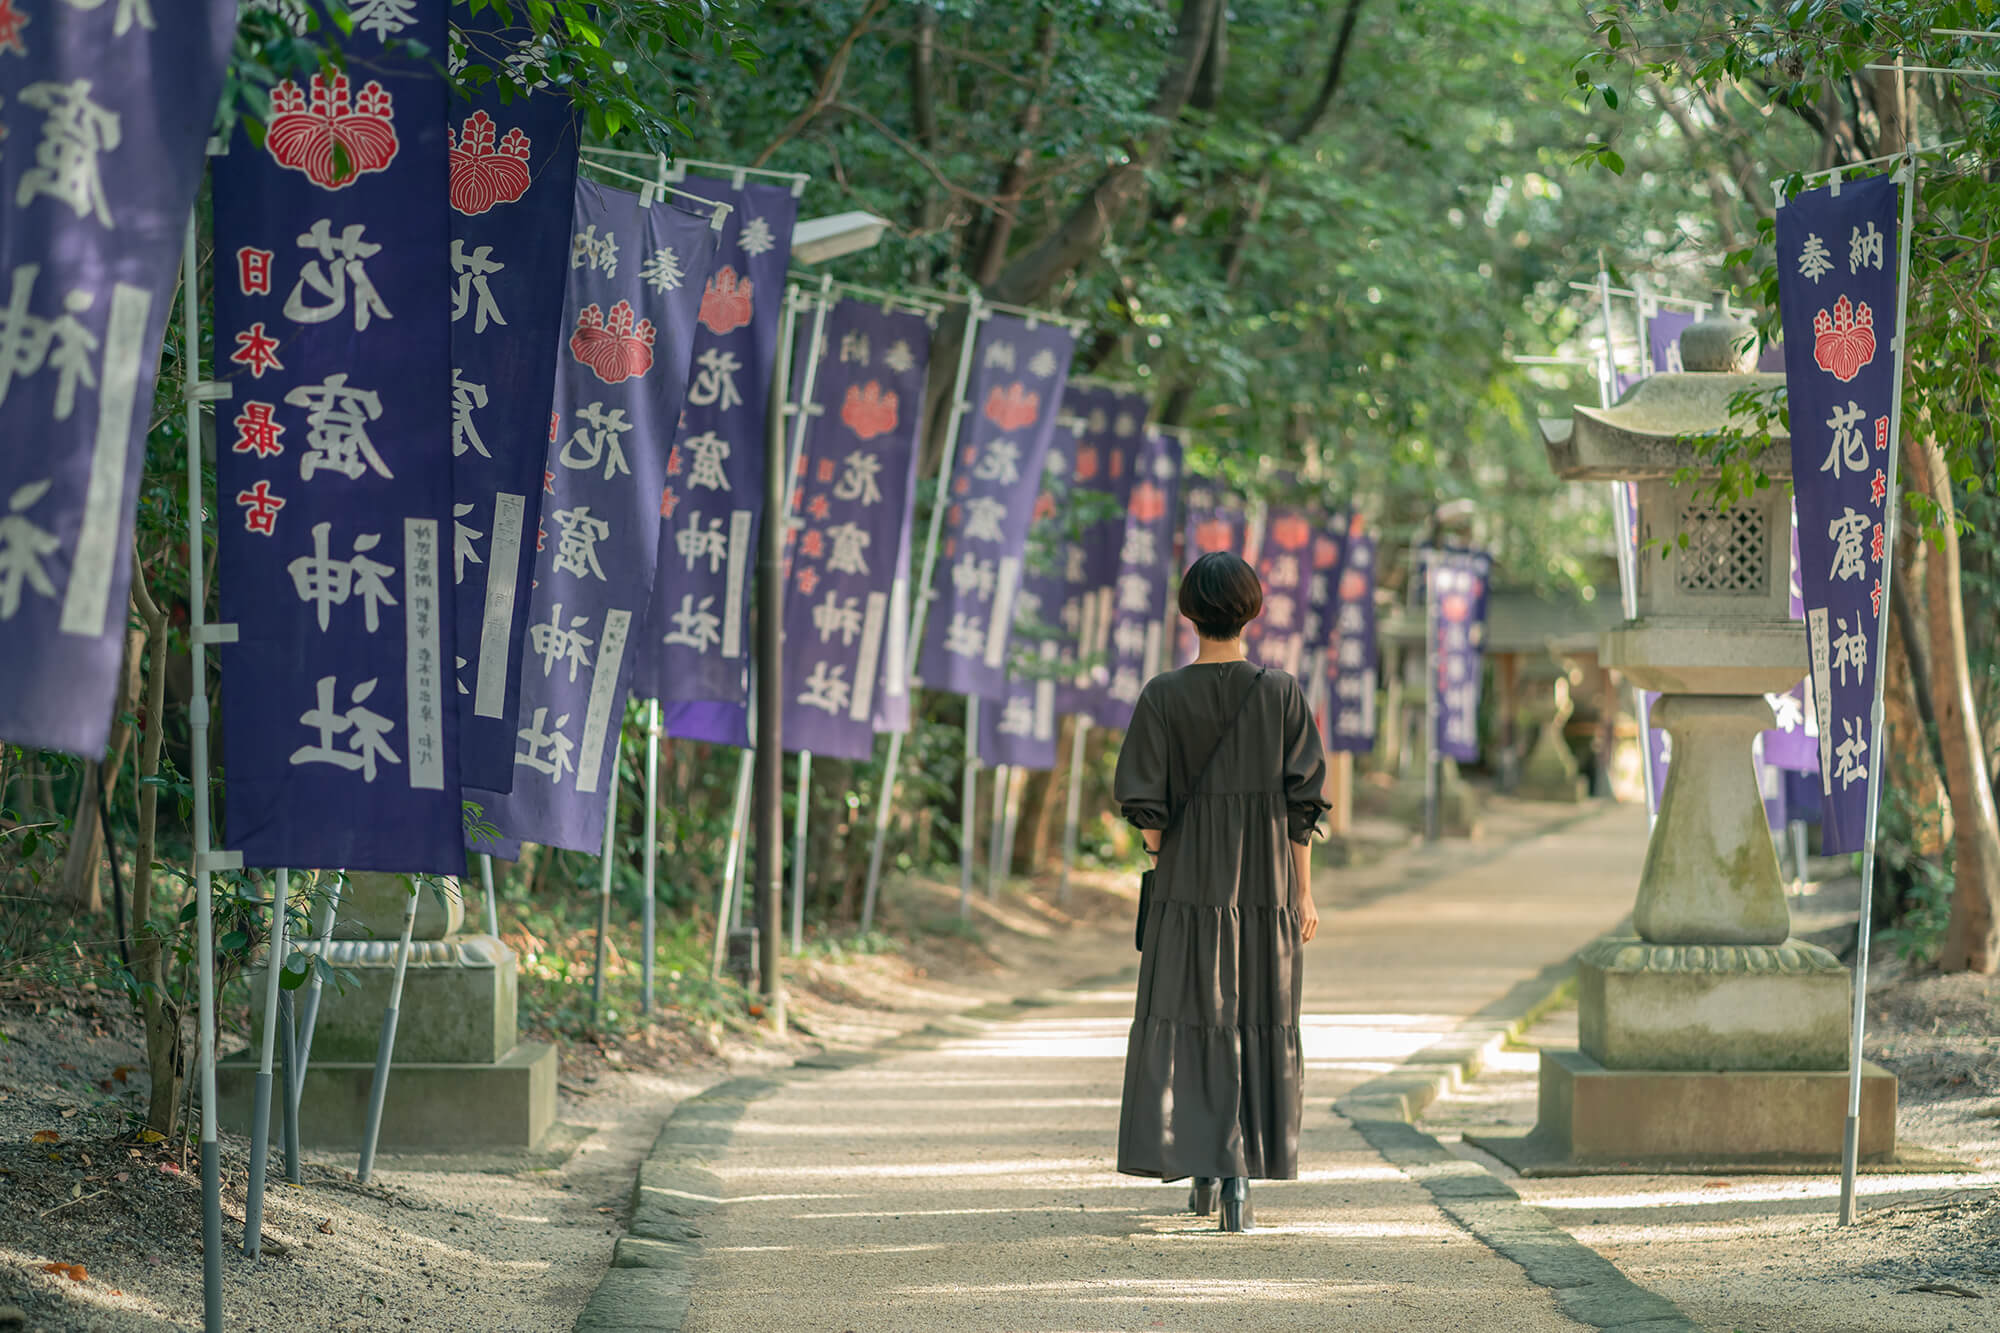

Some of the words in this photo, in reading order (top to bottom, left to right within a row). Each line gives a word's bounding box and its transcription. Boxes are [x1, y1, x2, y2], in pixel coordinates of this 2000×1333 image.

[1798, 222, 1884, 284] 奉納
[1820, 400, 1871, 794] 花窟神社
[1870, 415, 1889, 618] 日本最古
